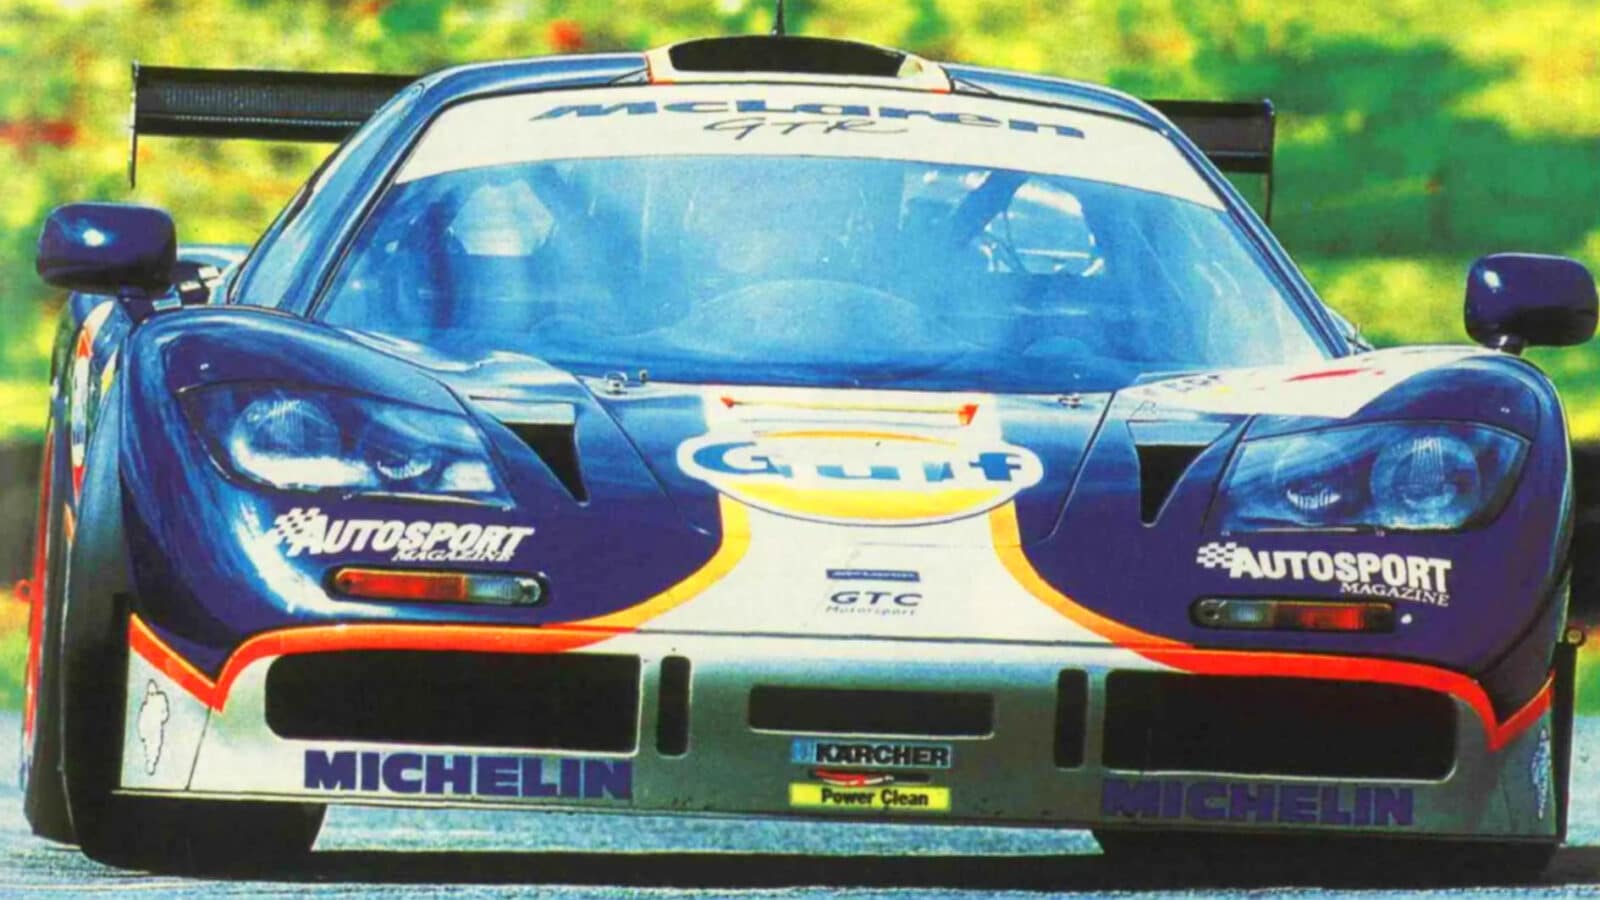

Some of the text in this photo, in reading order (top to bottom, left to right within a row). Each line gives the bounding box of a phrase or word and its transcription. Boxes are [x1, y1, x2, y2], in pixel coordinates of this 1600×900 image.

[529, 99, 1086, 139] McLaren
[702, 116, 909, 140] GTR
[693, 441, 1022, 482] Gulf
[287, 511, 535, 557] AUTOSPORT
[391, 549, 514, 563] MAGAZINE
[1229, 546, 1452, 593] AUTOSPORT
[830, 591, 923, 607] GTC
[1339, 582, 1450, 607] MAGAZINE
[304, 750, 634, 800] MICHELIN
[821, 787, 930, 807] Power Clean
[1103, 777, 1416, 827] MICHELIN
